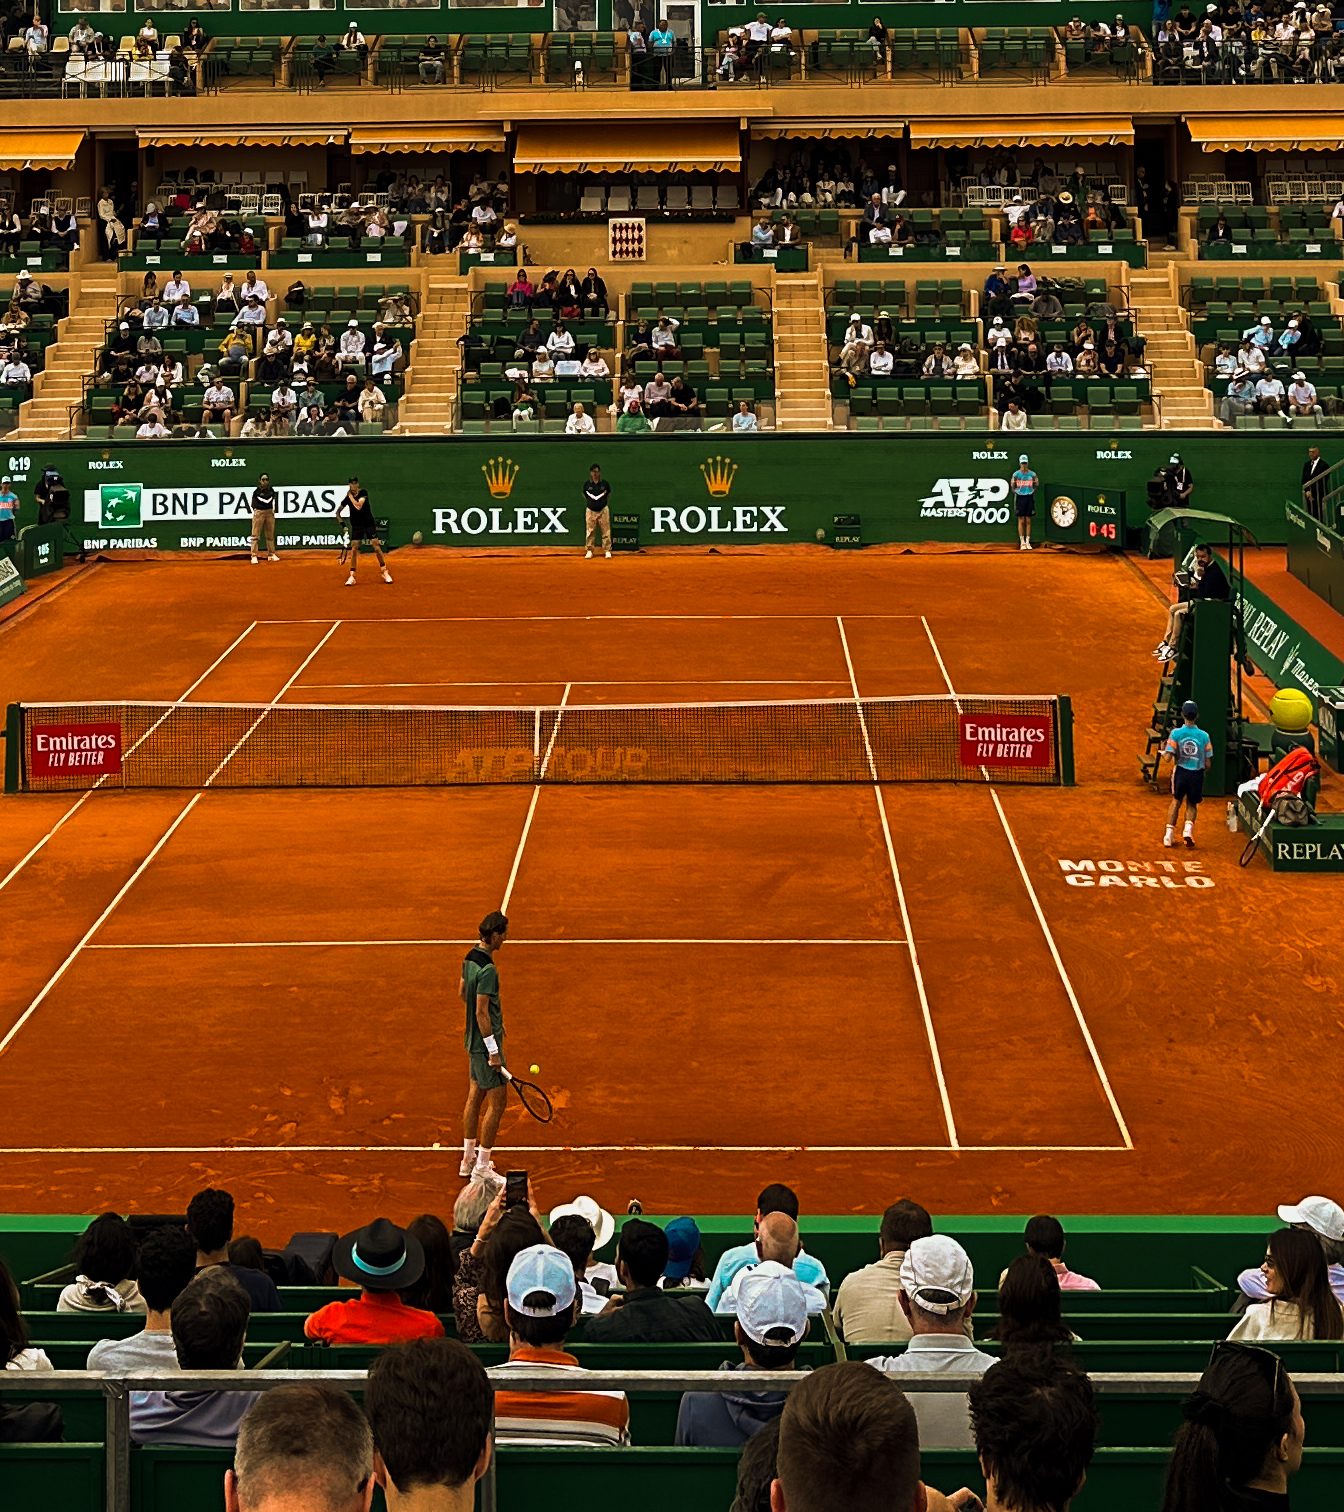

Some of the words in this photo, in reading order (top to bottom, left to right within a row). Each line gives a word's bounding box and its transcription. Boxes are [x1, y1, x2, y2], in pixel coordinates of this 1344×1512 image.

[211, 458, 246, 467] ROLEX
[972, 451, 1008, 460] ROLEX
[1096, 451, 1132, 460] ROLEX
[9, 457, 31, 471] 0:19
[88, 460, 124, 470] ROLEX
[917, 478, 1010, 507] ATP
[152, 493, 209, 516] BNP
[219, 489, 337, 515] PAIBAS
[1087, 504, 1117, 515] ROLEX
[432, 507, 569, 534] ROLEX
[650, 506, 788, 533] ROLEX
[920, 508, 967, 517] MASTERS
[966, 508, 1010, 524] 1000
[84, 539, 108, 550] BNP
[110, 538, 157, 549] PARIBAS
[180, 538, 205, 548] BNP
[276, 535, 301, 546] BNP
[1248, 611, 1290, 661] REPLAY
[964, 723, 1045, 743] Emirates
[36, 732, 116, 752] Emirates
[976, 742, 995, 758] FLY
[996, 743, 1033, 758] BETTER
[48, 752, 65, 767] FLY
[67, 751, 104, 766] BETTER
[1058, 859, 1206, 873] MONTE
[1064, 874, 1216, 888] CARLO
